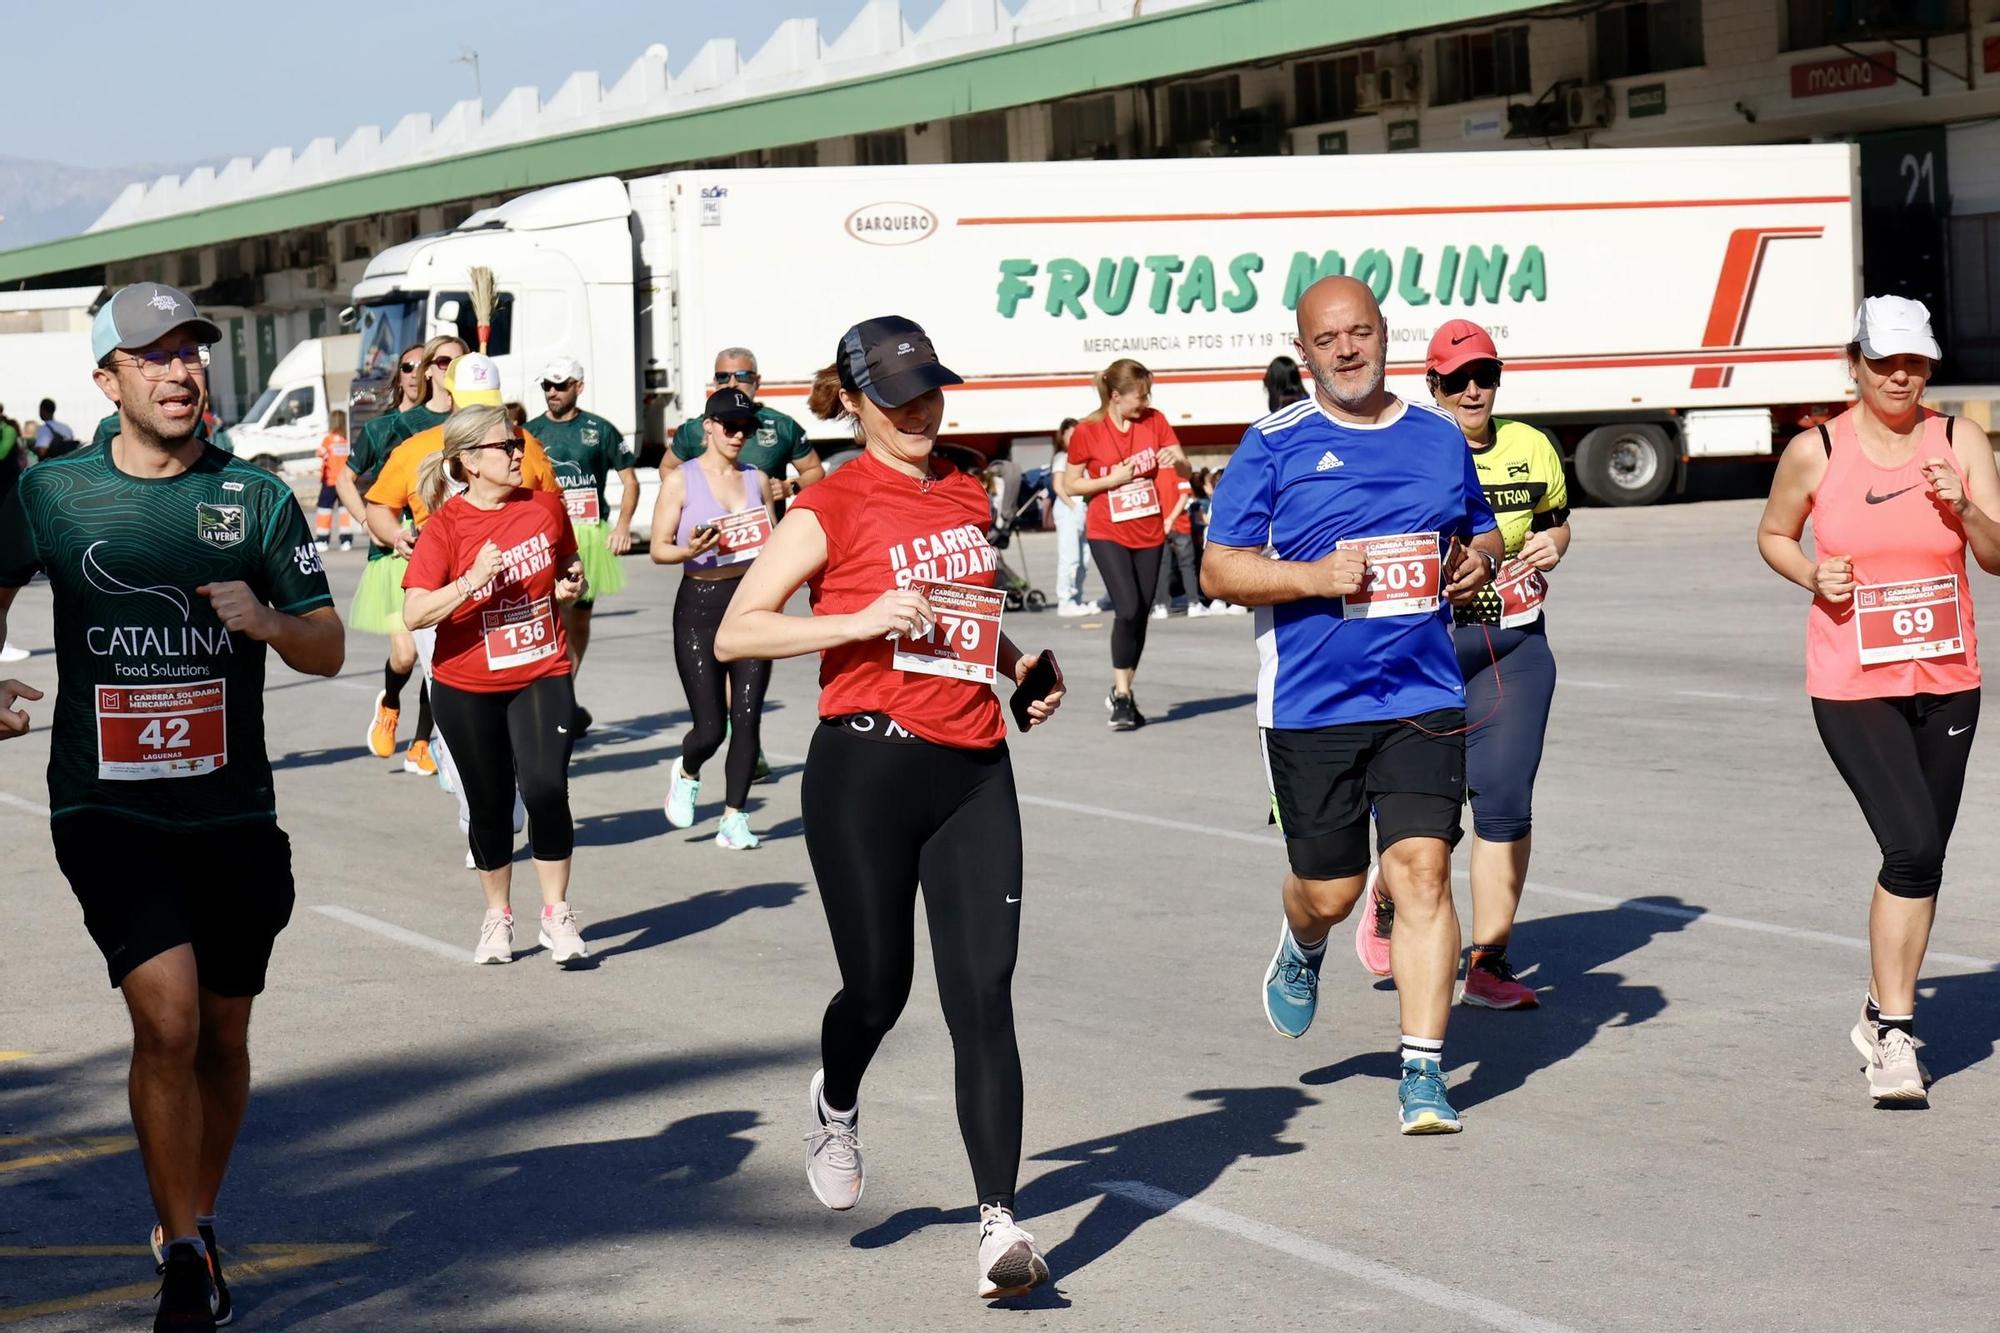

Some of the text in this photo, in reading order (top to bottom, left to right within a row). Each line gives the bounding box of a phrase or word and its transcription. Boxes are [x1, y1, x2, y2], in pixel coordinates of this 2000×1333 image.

[856, 216, 929, 231] BARQUERO
[997, 244, 1547, 320] FRUTAS MOLINA
[1084, 336, 1181, 352] MERCAMURCIA
[1188, 334, 1222, 350] PTOS
[1231, 334, 1243, 348] 17
[1247, 334, 1256, 347] Y
[1260, 333, 1273, 347] 19
[1391, 327, 1429, 342] MOVIL
[1316, 460, 1344, 471] adidas
[1121, 491, 1150, 508] 209
[202, 530, 240, 542] LA VERDE
[726, 526, 762, 548] 223
[889, 544, 908, 571] II
[1367, 562, 1427, 592] 203
[934, 588, 964, 599] CARRERA
[965, 593, 1001, 605] SOLIDARIA
[1884, 591, 1935, 602] MERCAMURCIA
[1887, 587, 1921, 597] CARRERA
[1922, 582, 1953, 592] SOLIDARIA
[928, 594, 977, 608] MERCAMURCIA
[1892, 607, 1934, 636] 69
[87, 626, 233, 656] CATALINA
[504, 620, 545, 648] 136
[934, 649, 960, 659] CRISTINA
[115, 663, 210, 677] Food Solutions
[134, 693, 174, 701] CARRERA
[176, 688, 220, 699] SOLIDARIA
[129, 699, 193, 709] MERCAMURCIA
[138, 718, 191, 750] 42
[143, 751, 182, 760] LAGUENAS
